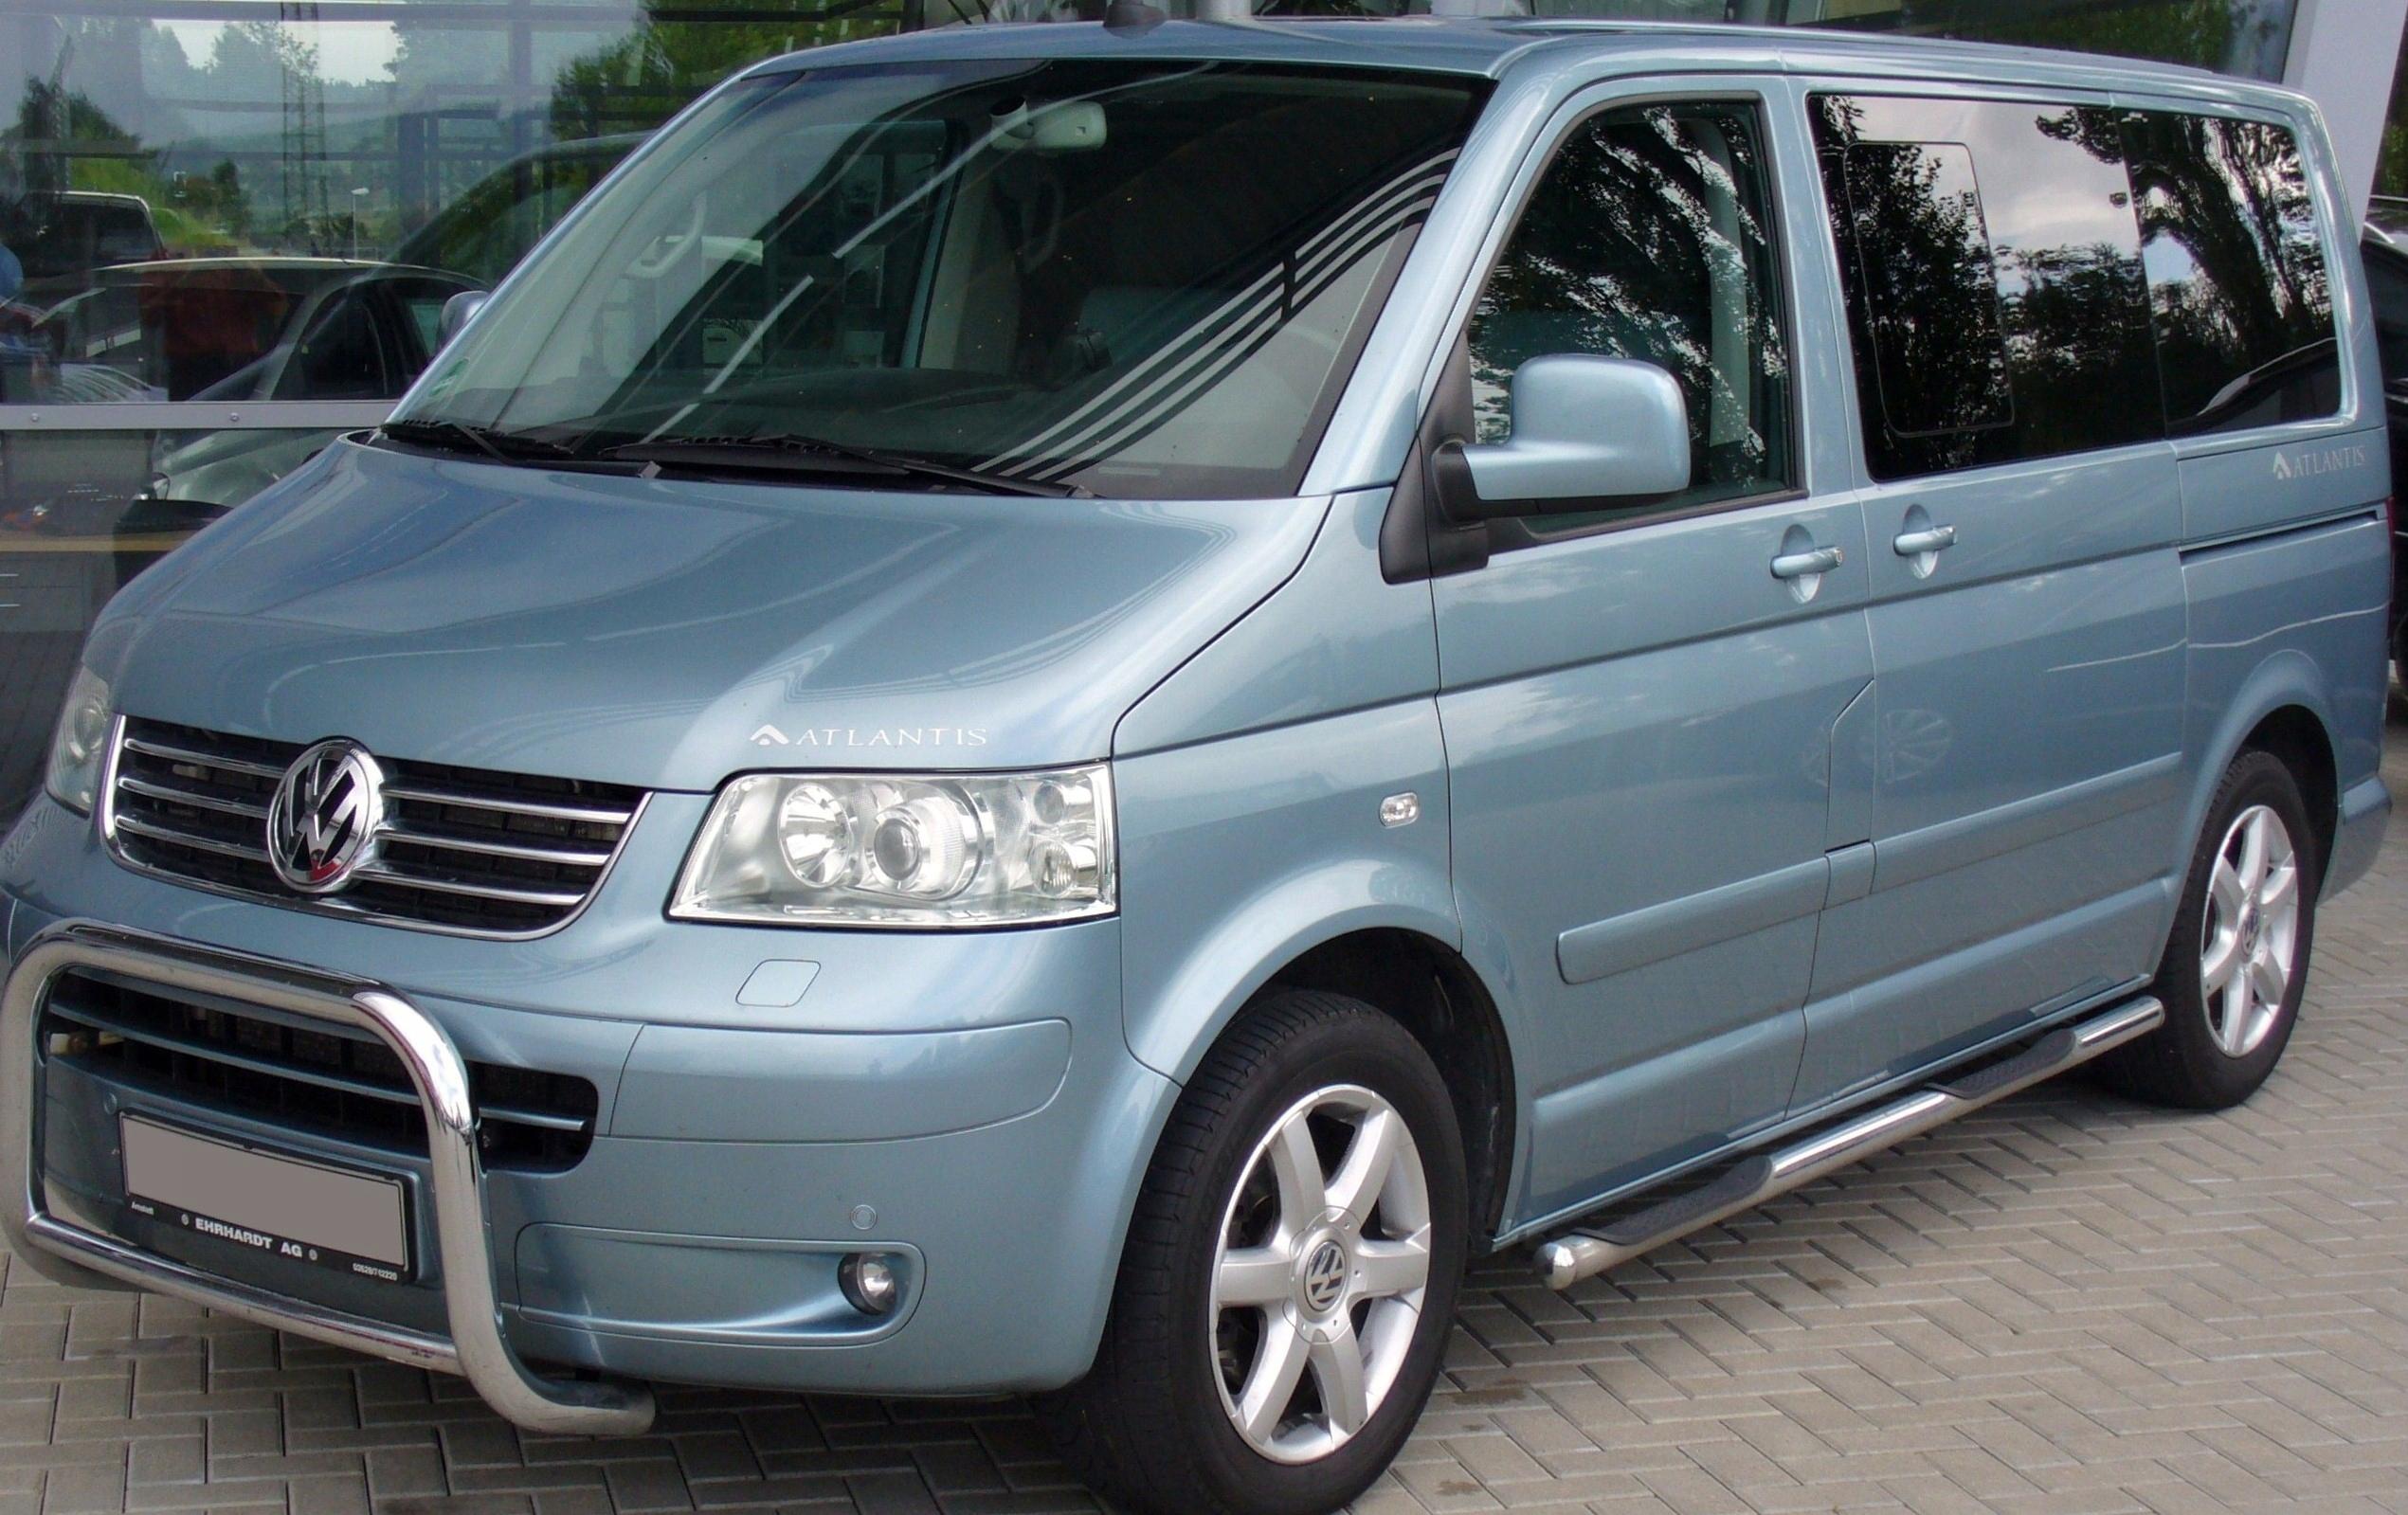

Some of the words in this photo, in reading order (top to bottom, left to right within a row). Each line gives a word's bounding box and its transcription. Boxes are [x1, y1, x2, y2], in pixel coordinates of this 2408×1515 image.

[2294, 445, 2366, 478] ATLANTIS
[796, 727, 987, 747] ATLANTIS
[195, 1217, 273, 1249] EHRHARDT
[281, 1241, 303, 1257] AG
